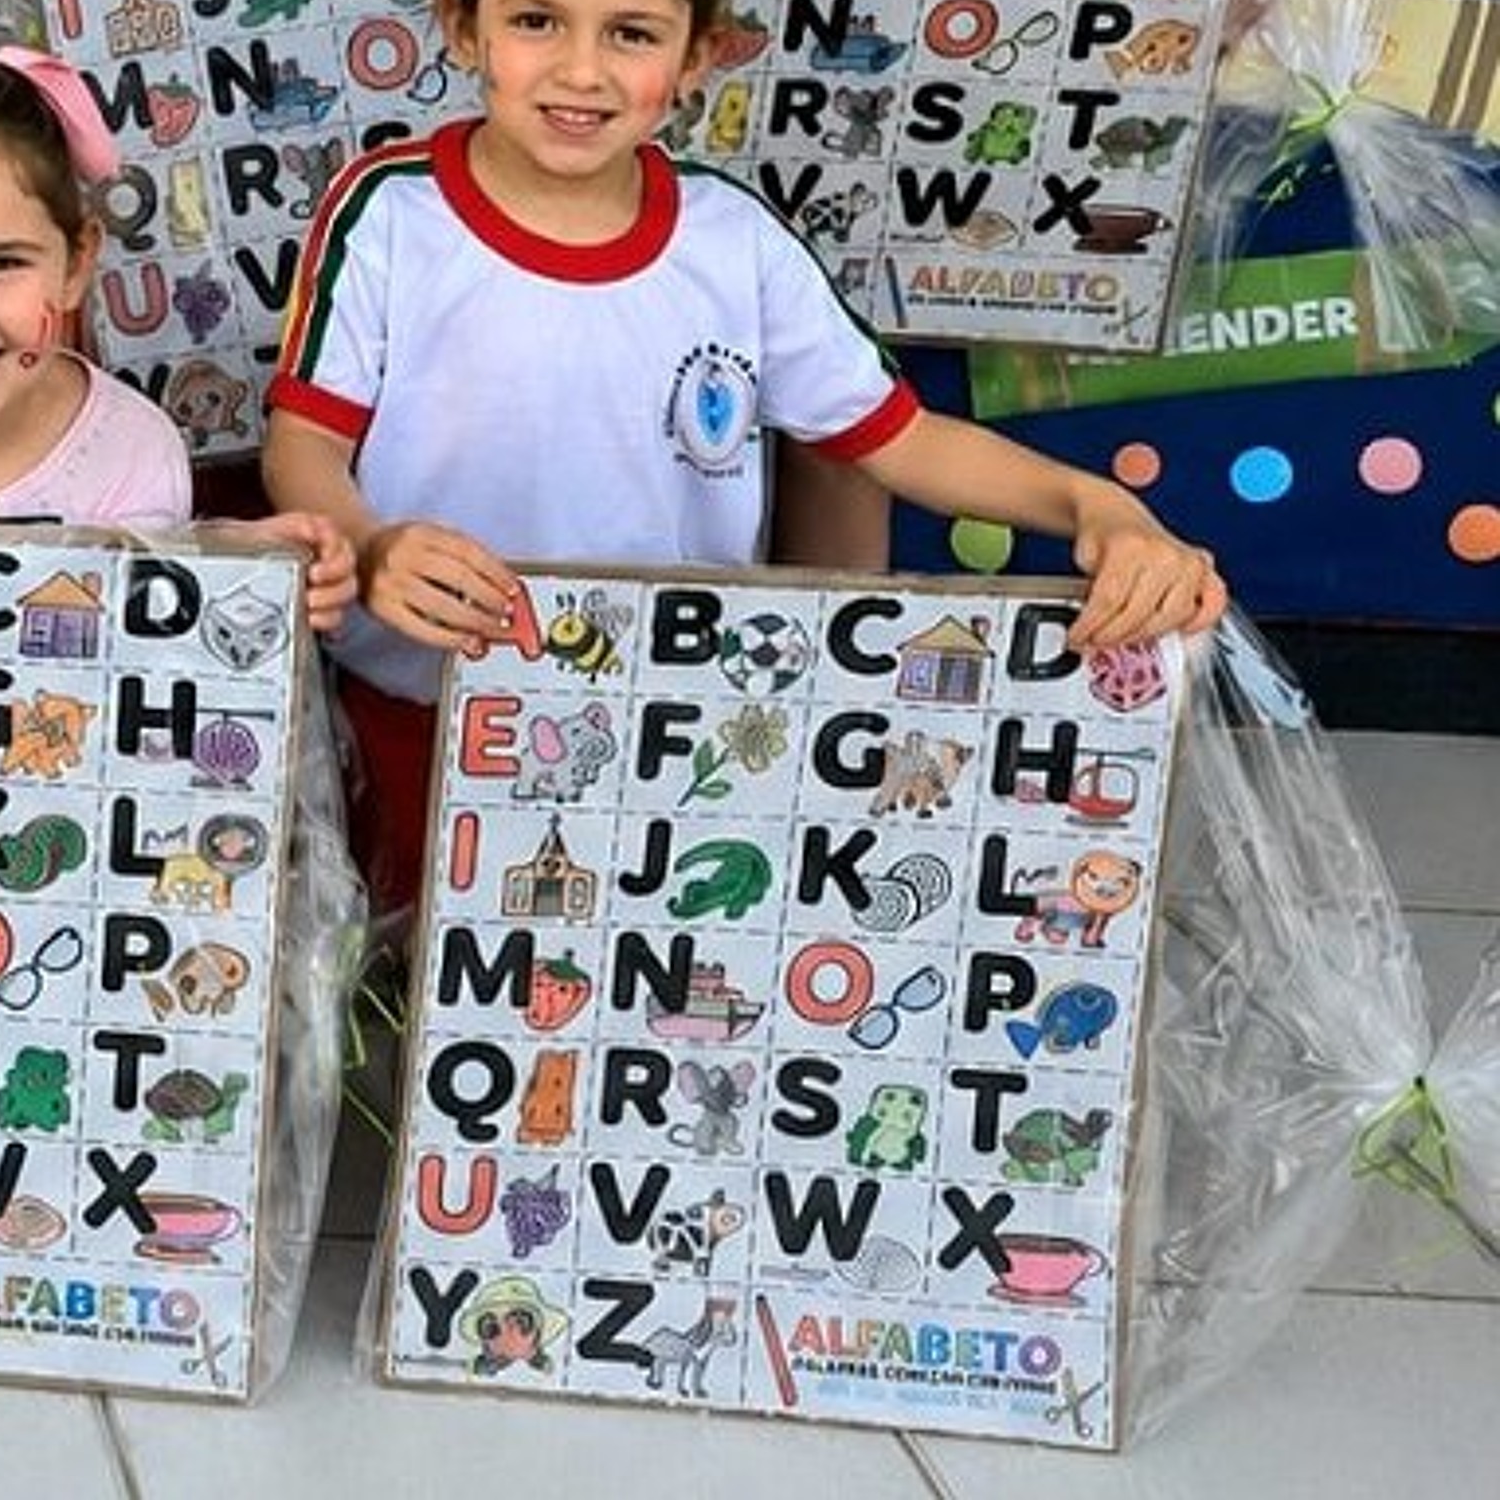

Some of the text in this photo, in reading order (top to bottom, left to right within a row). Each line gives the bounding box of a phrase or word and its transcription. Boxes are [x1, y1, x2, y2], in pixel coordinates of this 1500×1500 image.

[206, 17, 420, 115] N O
[1069, 1, 1133, 59] P
[769, 79, 1120, 150] R S T
[224, 143, 280, 214] R
[758, 163, 1099, 233] V W X
[104, 261, 171, 337] U
[1164, 297, 1358, 357] ENDER
[124, 560, 201, 637] D
[651, 589, 1081, 681] B C D
[115, 676, 197, 759] H
[458, 695, 1078, 803] E F G H
[108, 795, 162, 876] L
[450, 812, 1036, 916] I J K L
[102, 913, 171, 992] P
[437, 927, 1035, 1033] M N O P
[93, 1030, 165, 1110] T
[426, 1041, 1028, 1152] Q R S T
[84, 1149, 158, 1235] X
[415, 1154, 1017, 1273] U V W X
[407, 1266, 656, 1368] Y Z
[788, 1313, 1063, 1377] ALFABETO
